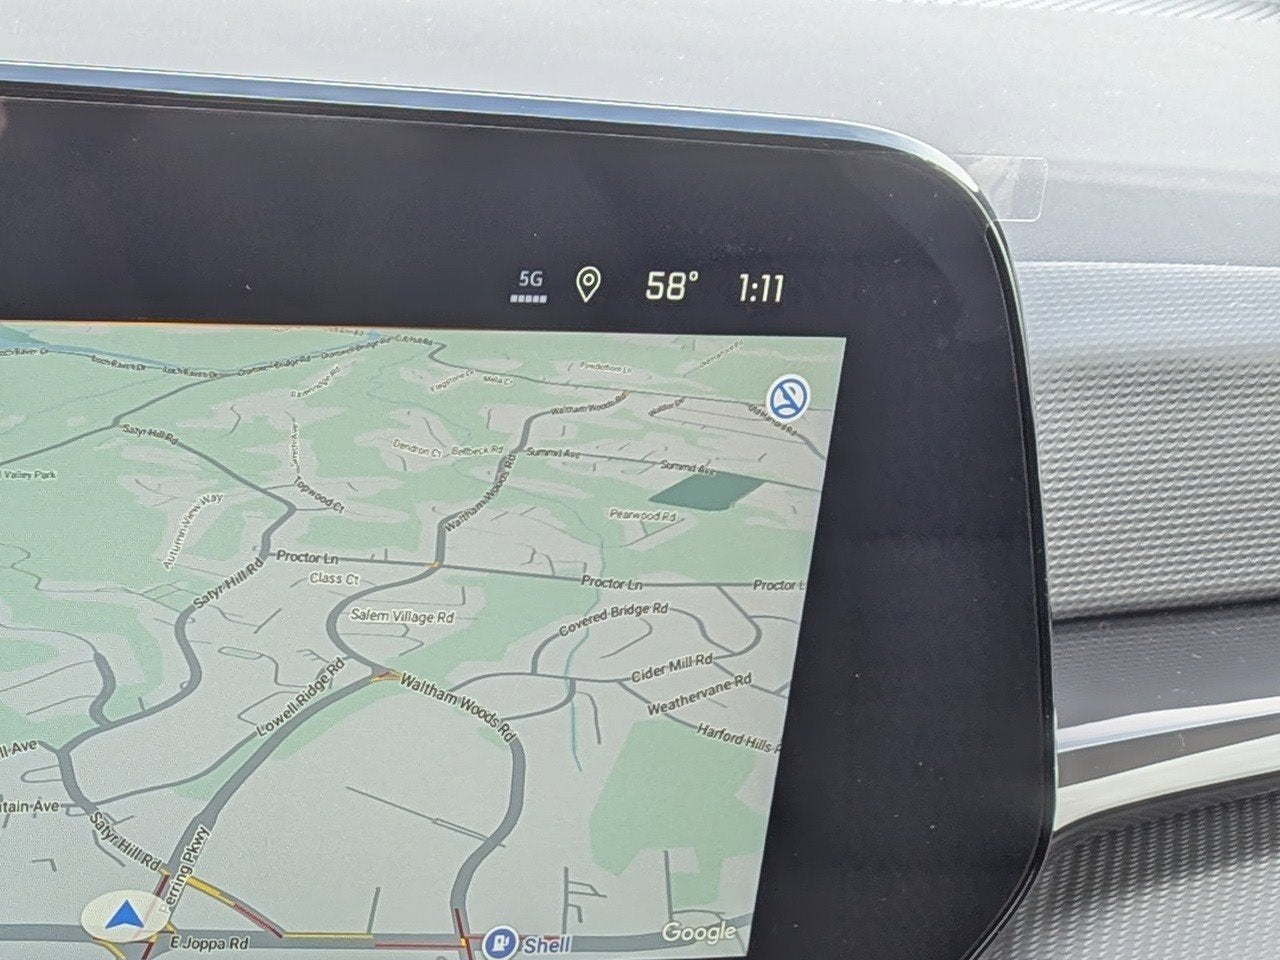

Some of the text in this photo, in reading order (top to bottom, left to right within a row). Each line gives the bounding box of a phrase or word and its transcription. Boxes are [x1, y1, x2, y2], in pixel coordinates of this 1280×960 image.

[519, 270, 543, 287] 5G
[646, 271, 699, 300] 58°
[739, 273, 783, 302] 1:11
[4, 470, 32, 481] Valley
[34, 470, 56, 479] Park
[294, 475, 335, 506] Topwood
[445, 500, 486, 532] Waltham
[484, 471, 511, 502] Woods
[609, 509, 676, 522] Pearwood Rd
[163, 528, 186, 569] Autumn
[200, 494, 224, 506] Way
[276, 550, 339, 564] Proctor Ln
[193, 556, 264, 609] Satyr Hill Rd
[310, 572, 360, 585] Class Ct
[581, 574, 643, 589] Proctor Ln
[753, 579, 796, 590] Proctor
[350, 608, 455, 625] Salem Village Rd
[559, 602, 669, 636] Covered Bridge Rd
[631, 653, 714, 683] Cider Mill Rd
[256, 656, 346, 737] Lowell Ridge Rd
[400, 672, 518, 744] Waltham Woods Rd
[647, 672, 752, 716] Weathervane Rd
[11, 738, 38, 754] Ave
[696, 721, 745, 745] Harford
[745, 736, 772, 753] Hills
[32, 800, 59, 814] Ave
[89, 811, 163, 872] Satyr Hill Rd
[182, 826, 211, 864] Pkwy
[170, 936, 249, 952] E Joppa Rd
[523, 936, 571, 955] Shell
[661, 921, 737, 945] Google
